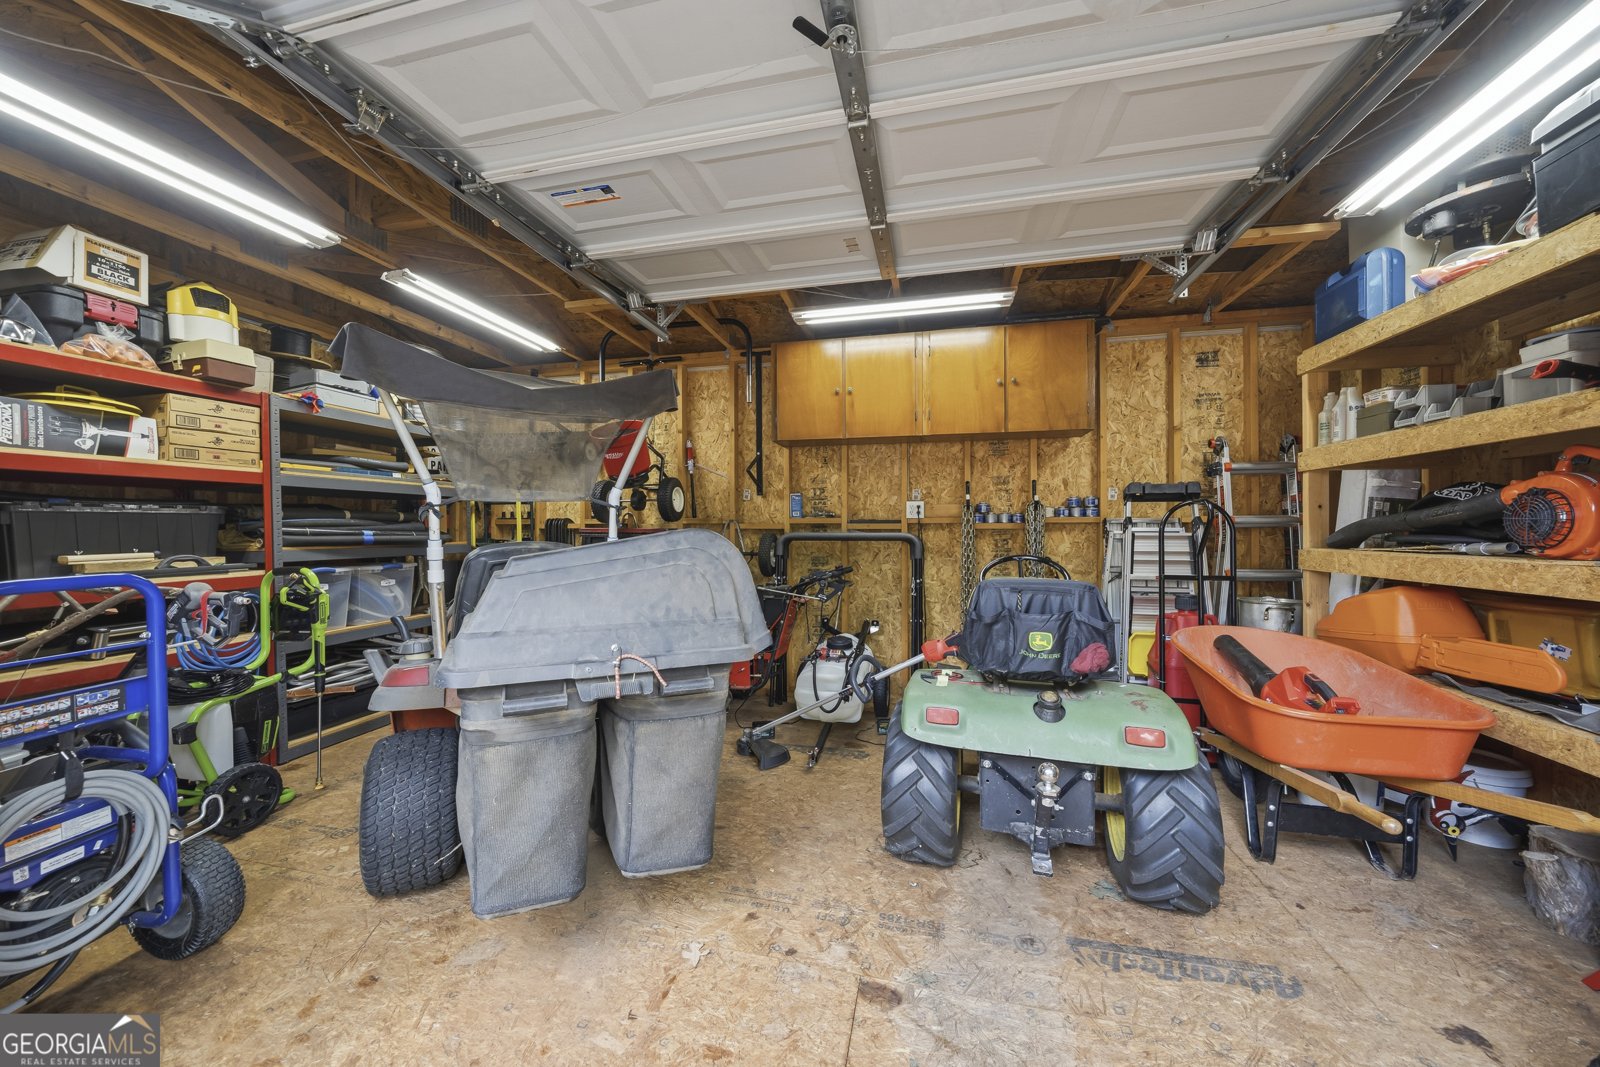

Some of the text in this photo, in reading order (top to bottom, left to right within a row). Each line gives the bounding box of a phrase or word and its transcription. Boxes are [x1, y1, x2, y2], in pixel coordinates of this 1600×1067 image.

[97, 267, 130, 283] BLACK
[1019, 649, 1037, 659] JOHN
[1098, 948, 1304, 1001] AdvanTech
